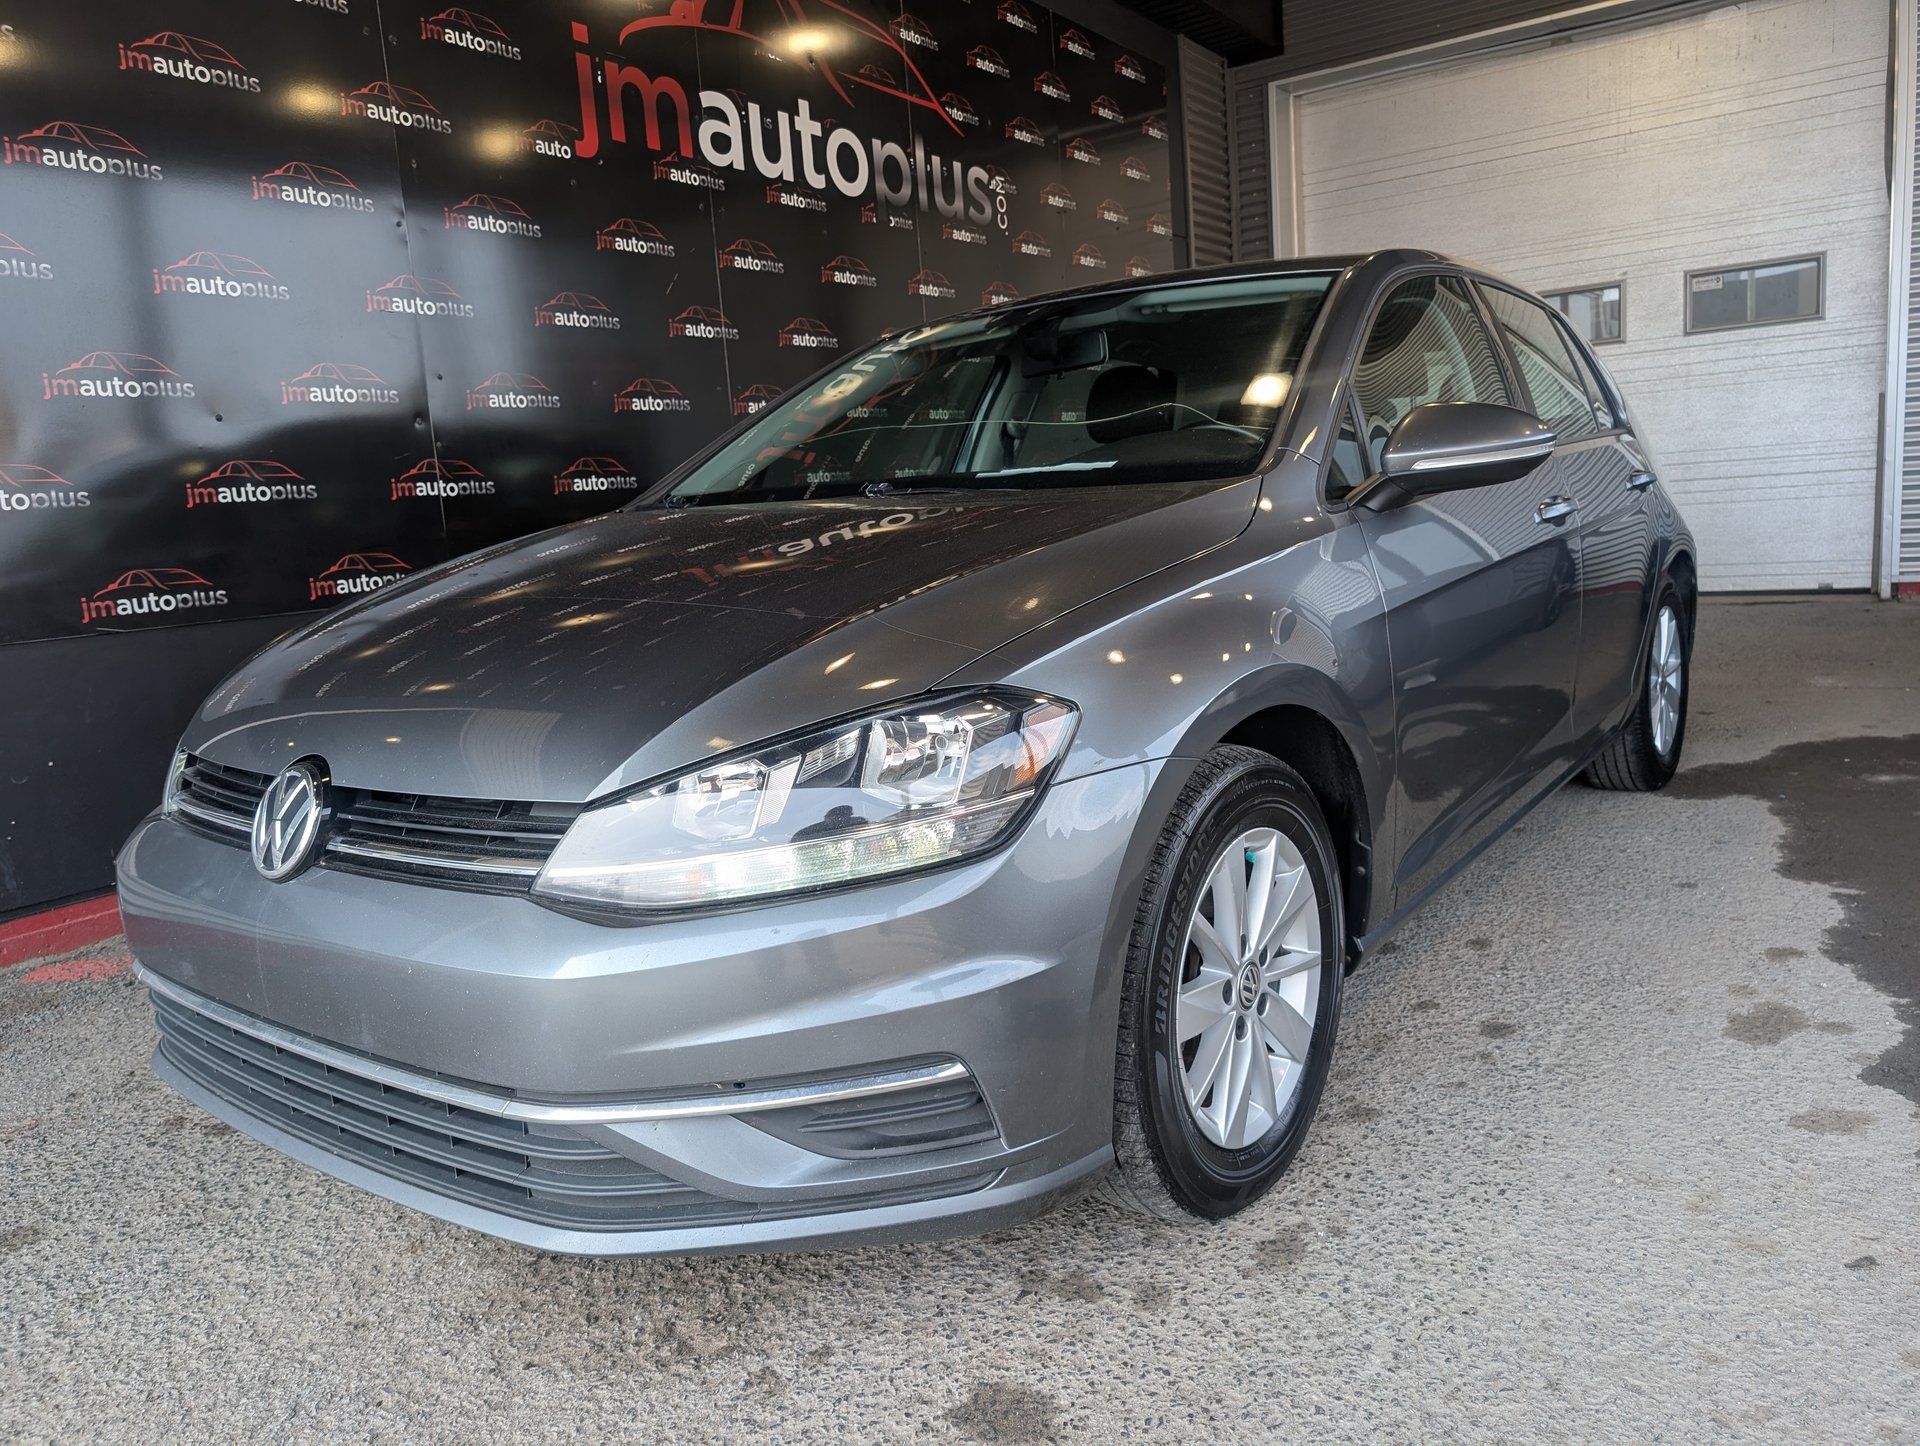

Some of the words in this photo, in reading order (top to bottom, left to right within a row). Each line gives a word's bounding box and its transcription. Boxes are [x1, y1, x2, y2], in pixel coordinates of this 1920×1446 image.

[420, 16, 522, 61] jmautoplus
[888, 19, 939, 52] jmautoplus
[118, 43, 261, 94] jmautoplus
[339, 93, 452, 134] jmautoplus
[571, 22, 993, 227] jmautoplus
[3, 136, 163, 182] jmautoplus
[653, 162, 725, 192] jmautoplus
[251, 176, 375, 214] jmautoplus
[766, 186, 827, 213] jmautoplus
[444, 206, 542, 239] jmautoplus
[596, 229, 675, 258] jmautoplus
[719, 250, 784, 275] jmautoplus
[153, 268, 290, 302] jmautoplus
[821, 267, 877, 287] jmautoplus
[907, 279, 956, 299] jmautoplus
[365, 290, 475, 319] jmautoplus
[534, 305, 620, 331] jmautoplus
[668, 318, 740, 341] jmautoplus
[778, 330, 839, 349] jmautoplus
[42, 373, 195, 400] jmautoplus
[281, 381, 399, 405] jmautoplus
[467, 389, 561, 410] jmautoplus
[613, 392, 690, 414] jmautoplus
[186, 482, 318, 510] jmautoplus
[390, 477, 495, 501] jmautoplus
[553, 474, 638, 495] jmautoplus
[81, 588, 228, 624] jmautoplus
[1154, 820, 1220, 1037] BRIDGESTONE
